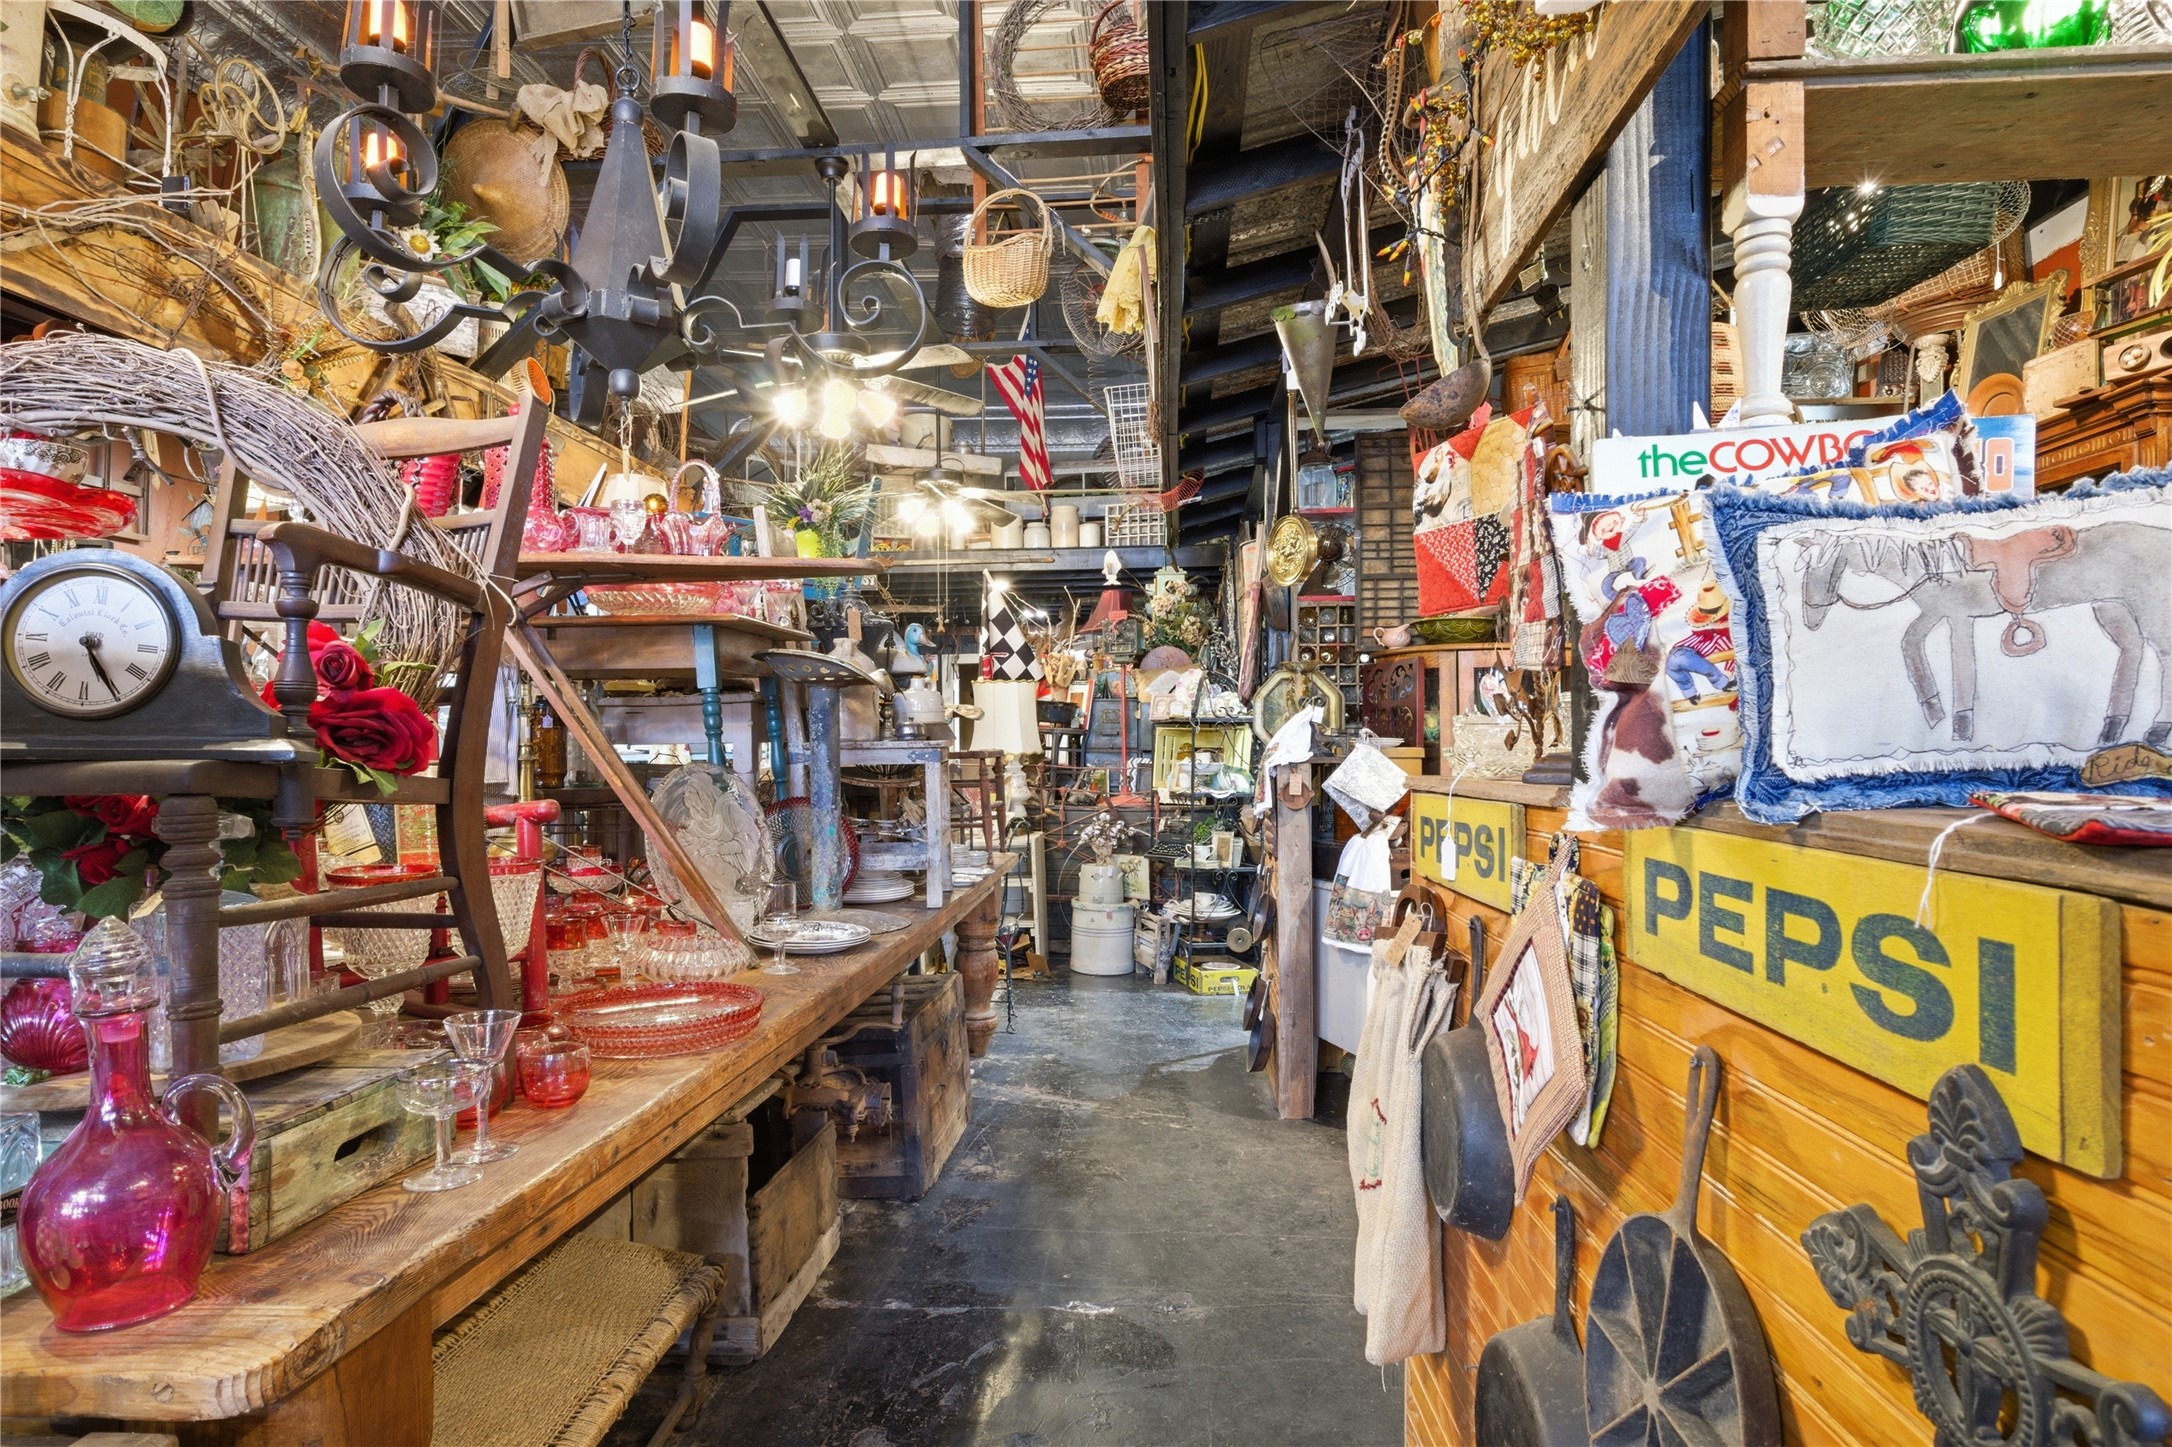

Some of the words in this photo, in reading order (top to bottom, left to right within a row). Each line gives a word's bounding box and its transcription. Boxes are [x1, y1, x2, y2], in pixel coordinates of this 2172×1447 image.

[58, 607, 96, 628] Colonial
[97, 608, 121, 625] Clock
[1175, 964, 1199, 989] PESI
[1643, 856, 2017, 1076] PEPSI
